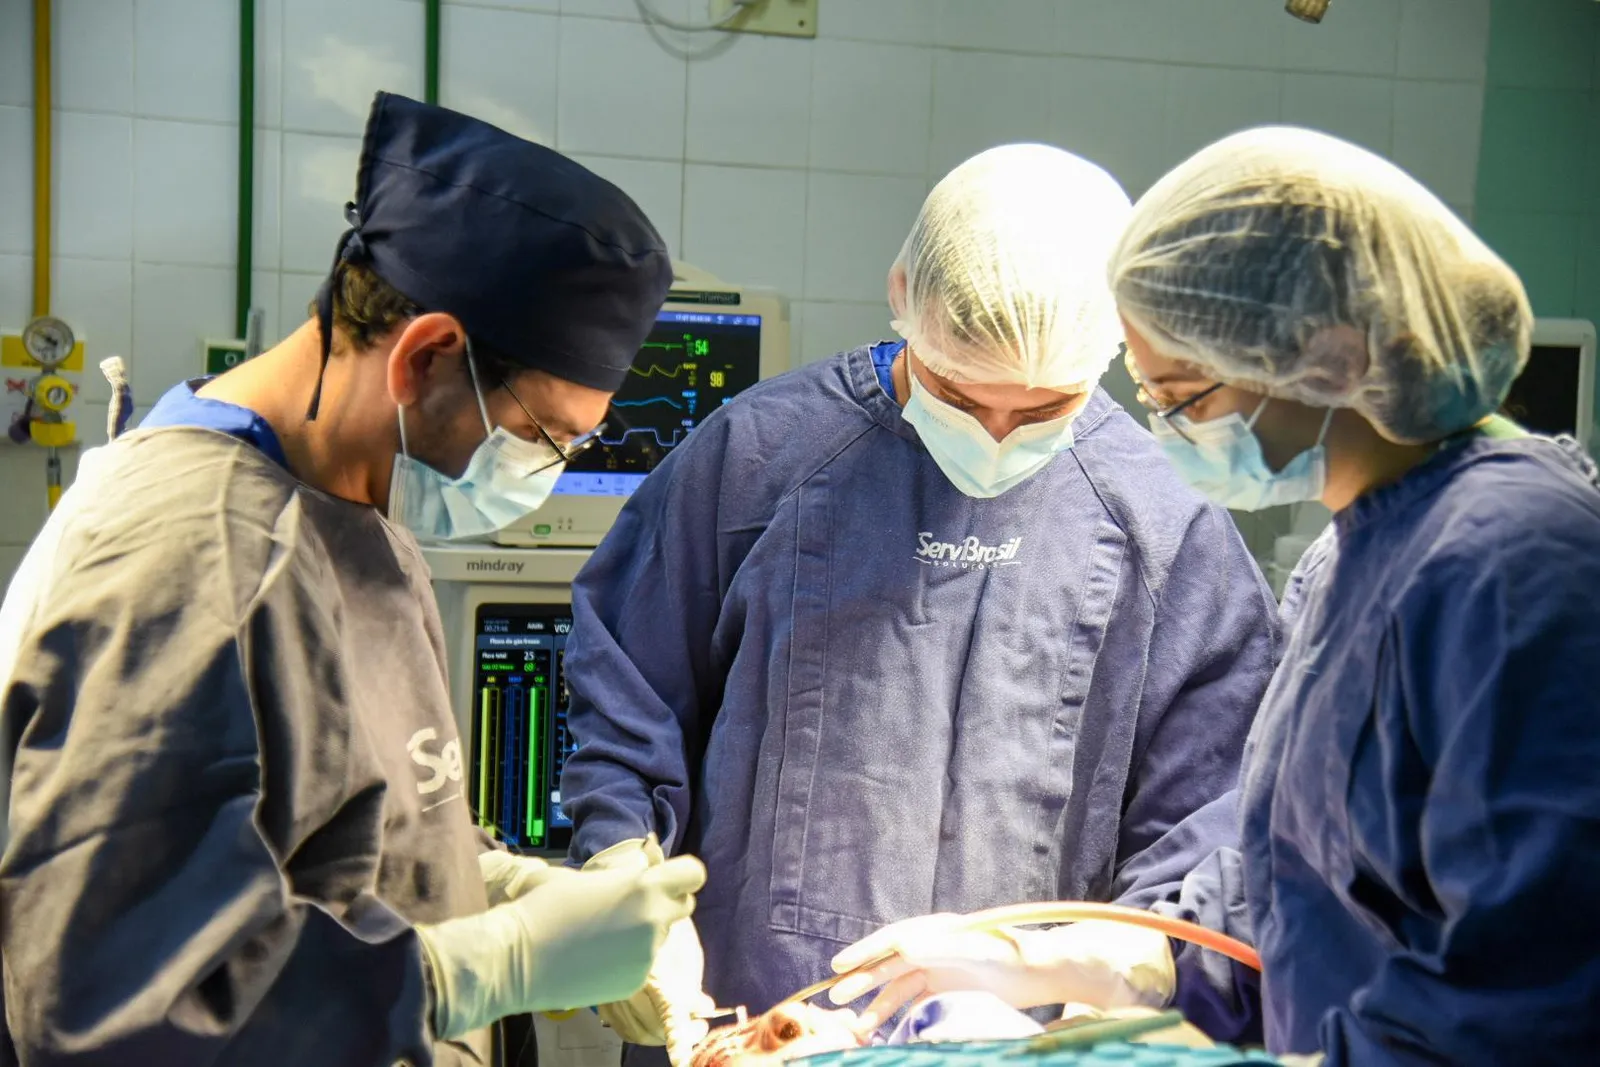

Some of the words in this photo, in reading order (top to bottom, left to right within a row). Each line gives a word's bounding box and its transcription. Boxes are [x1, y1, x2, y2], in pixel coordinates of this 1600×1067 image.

[710, 372, 724, 388] 98
[916, 532, 1022, 563] ServBrasil
[467, 559, 524, 574] mindray
